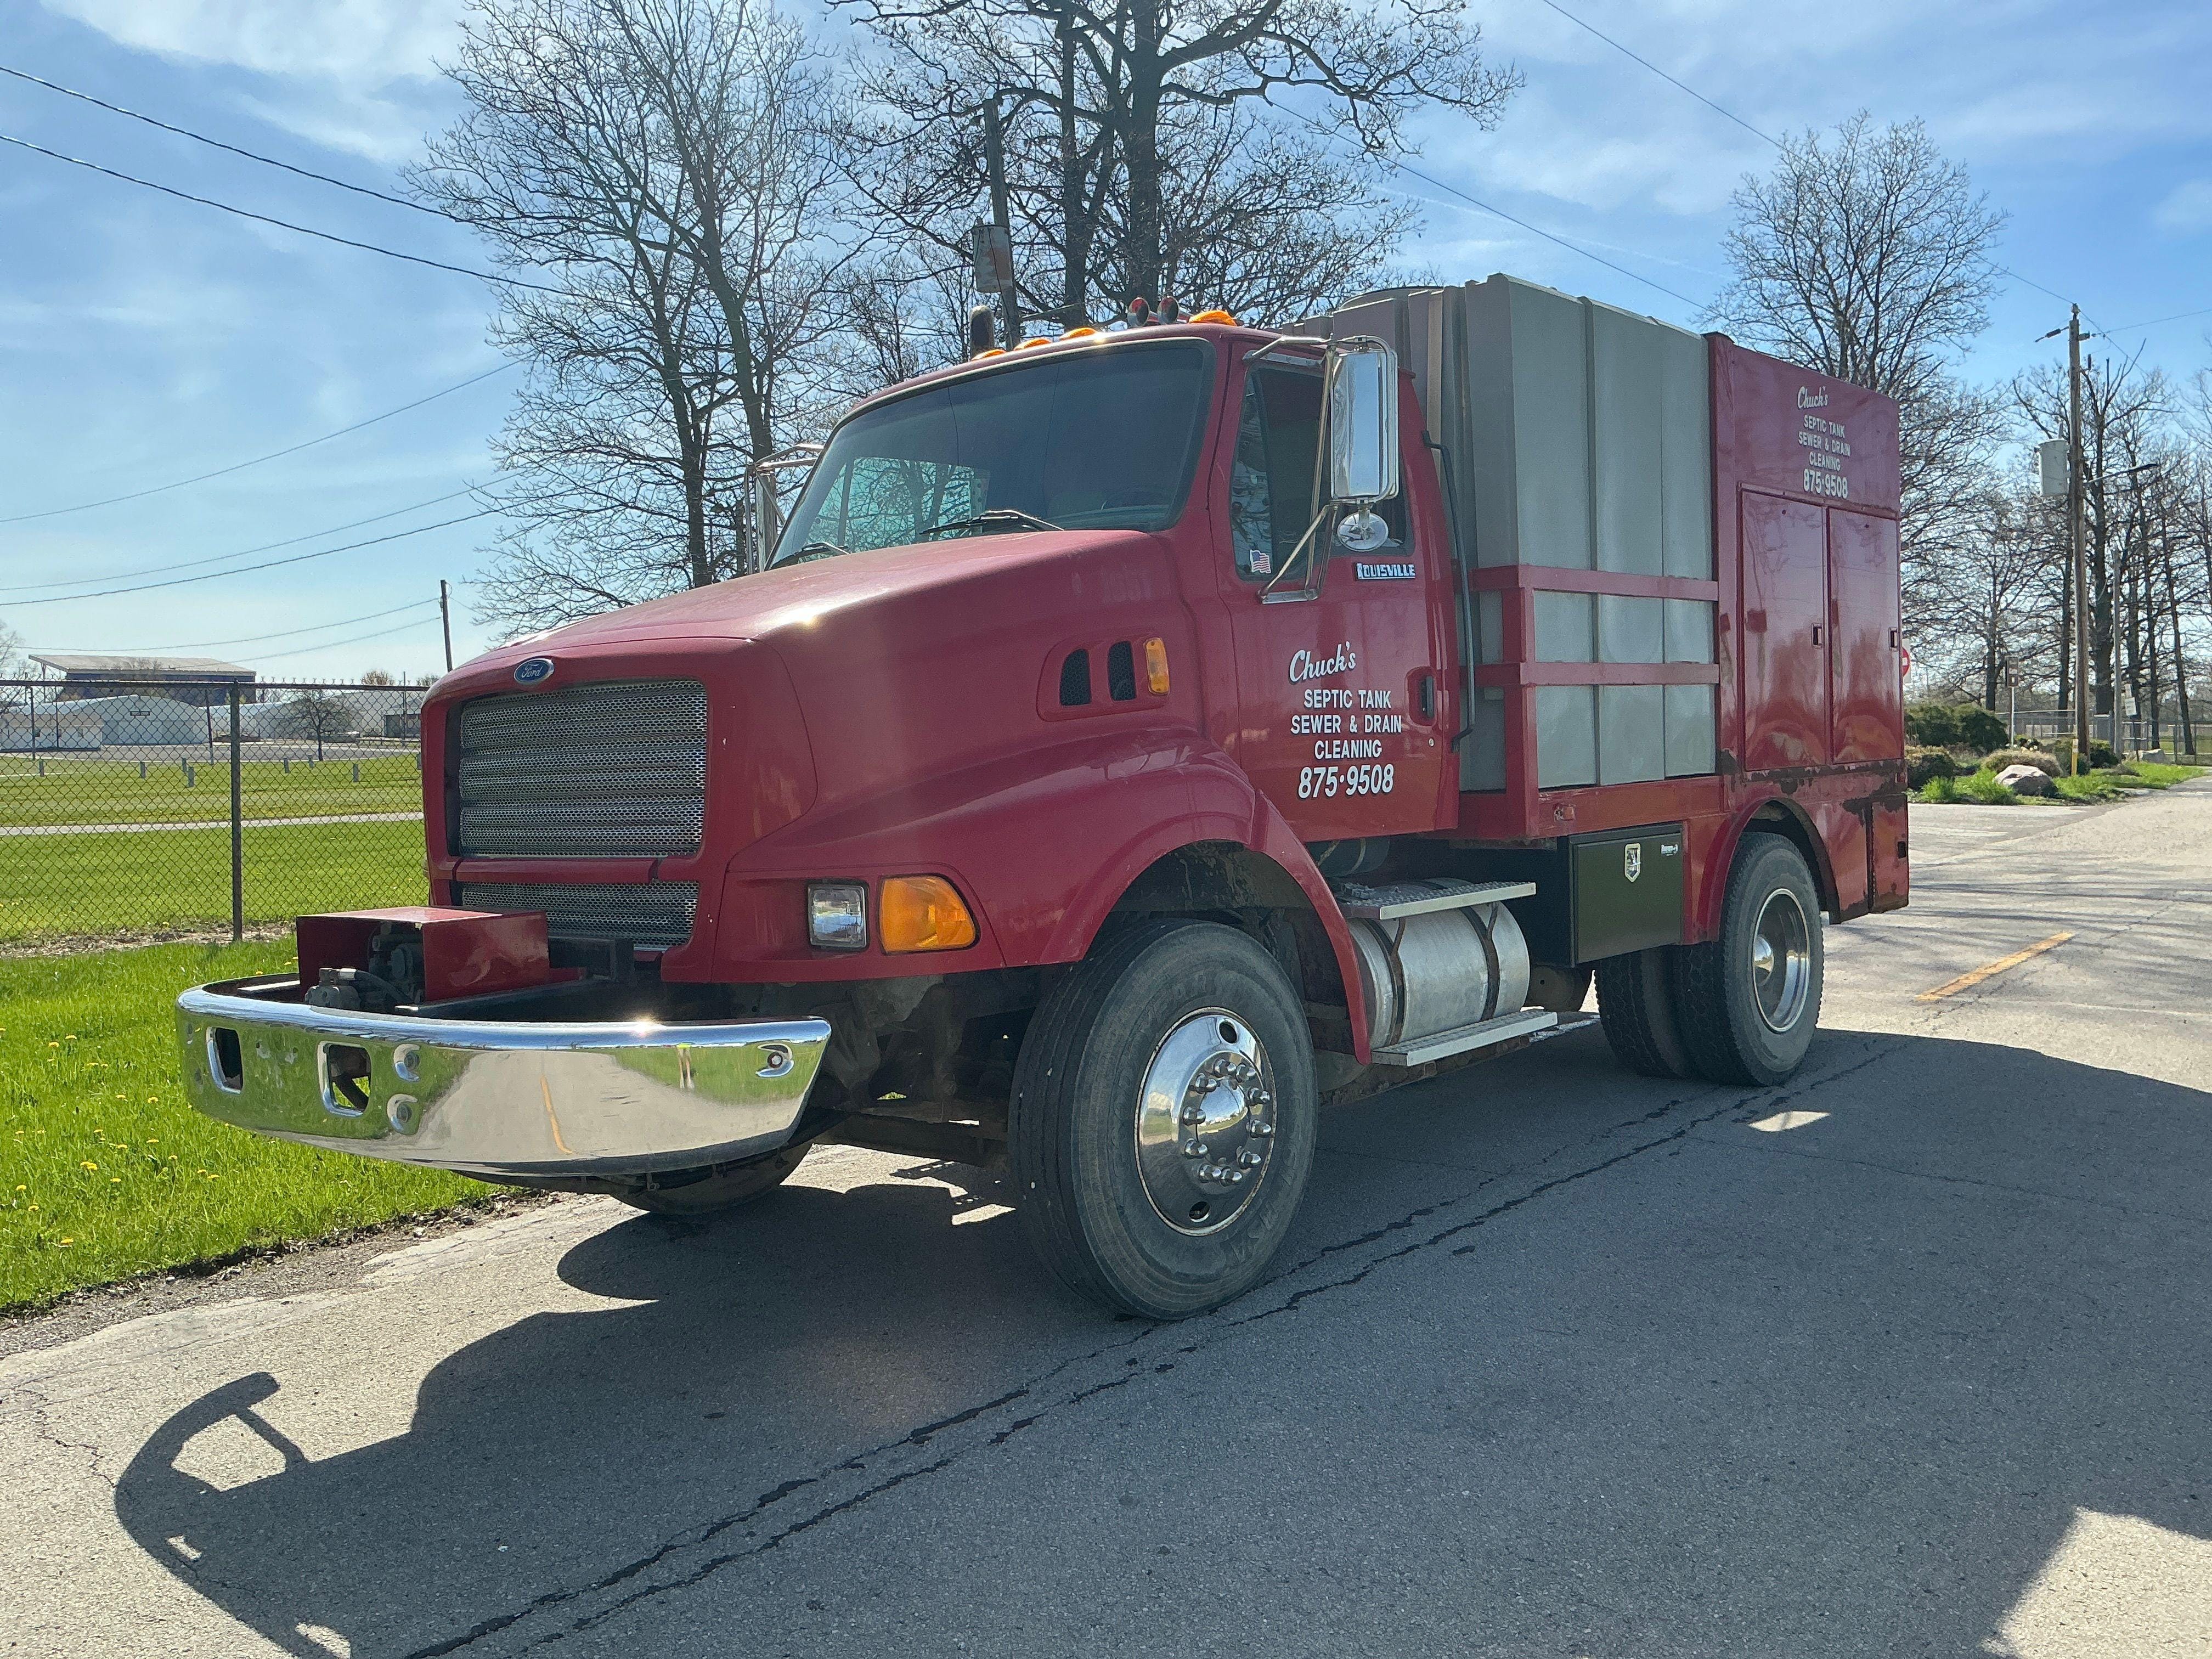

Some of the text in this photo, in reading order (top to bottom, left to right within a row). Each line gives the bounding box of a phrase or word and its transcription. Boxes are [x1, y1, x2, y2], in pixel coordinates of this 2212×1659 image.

[1797, 386, 1829, 409] Chuck's
[1803, 414, 1845, 438] SEPTIC TANK
[1798, 431, 1850, 456] SEWER & DRAIN
[1809, 452, 1841, 471] CLEANING
[1356, 563, 1416, 580] LOUISVILLE
[521, 663, 543, 678] Ford
[1289, 641, 1357, 682] Chuck's
[1304, 689, 1392, 709] SEPTIC TANK
[1290, 715, 1402, 734] SEWER & DRAIN
[1314, 739, 1383, 759] CLEANING
